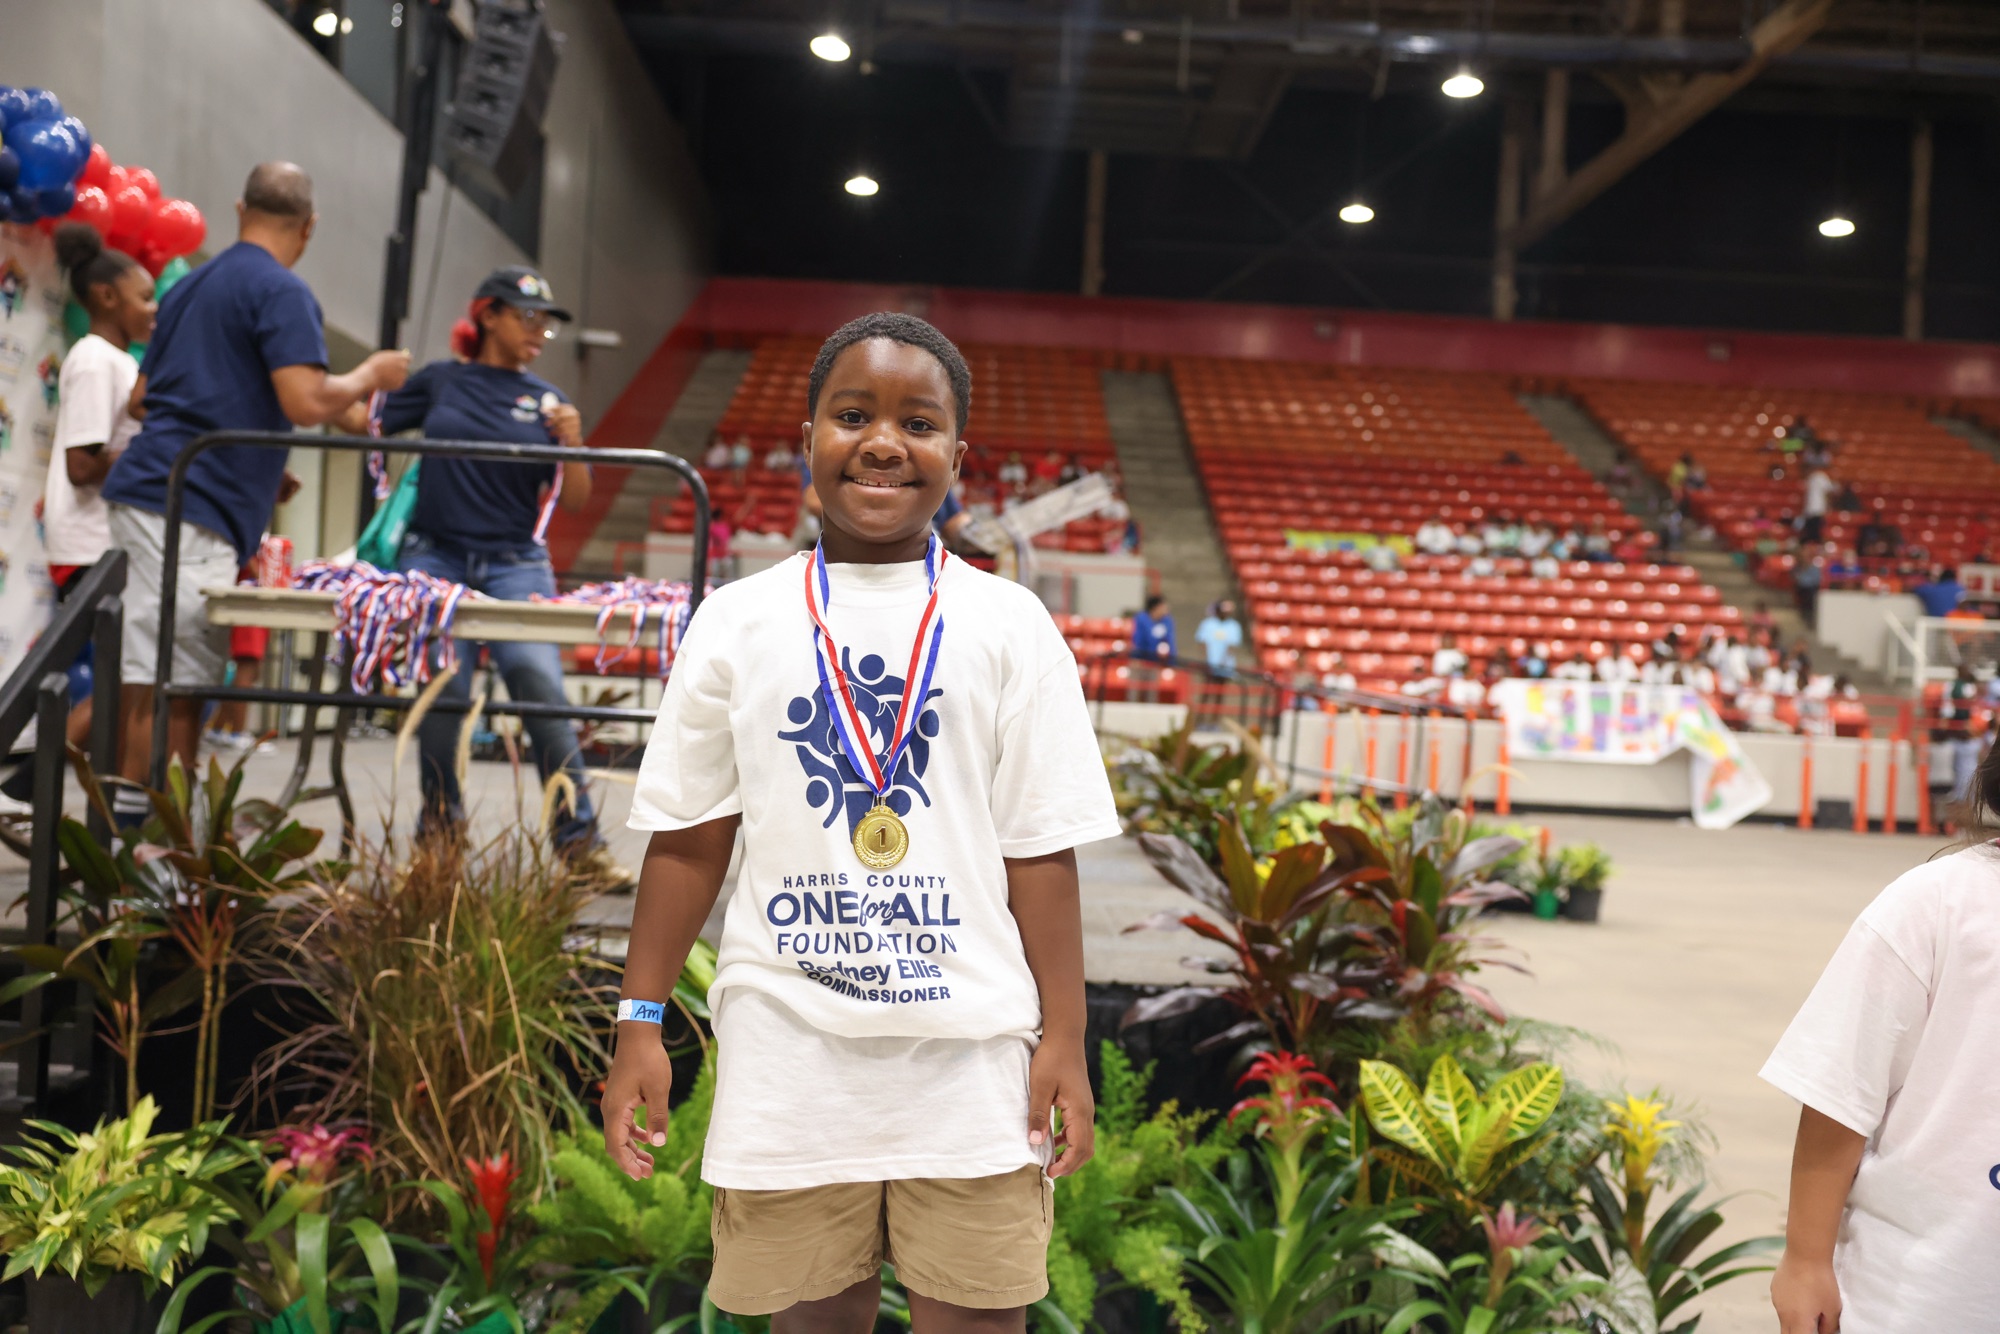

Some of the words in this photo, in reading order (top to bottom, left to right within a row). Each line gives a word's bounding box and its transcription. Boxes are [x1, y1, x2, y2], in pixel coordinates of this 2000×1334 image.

[875, 825, 886, 847] 1
[783, 872, 848, 888] HARRIS
[866, 874, 946, 888] COUNTY
[766, 890, 859, 926] ONE
[881, 892, 961, 926] ALL
[777, 931, 957, 955] FOUNDATION
[797, 960, 891, 985] Rodney
[896, 958, 942, 979] Ellis
[807, 971, 951, 1004] COMMISSIONER
